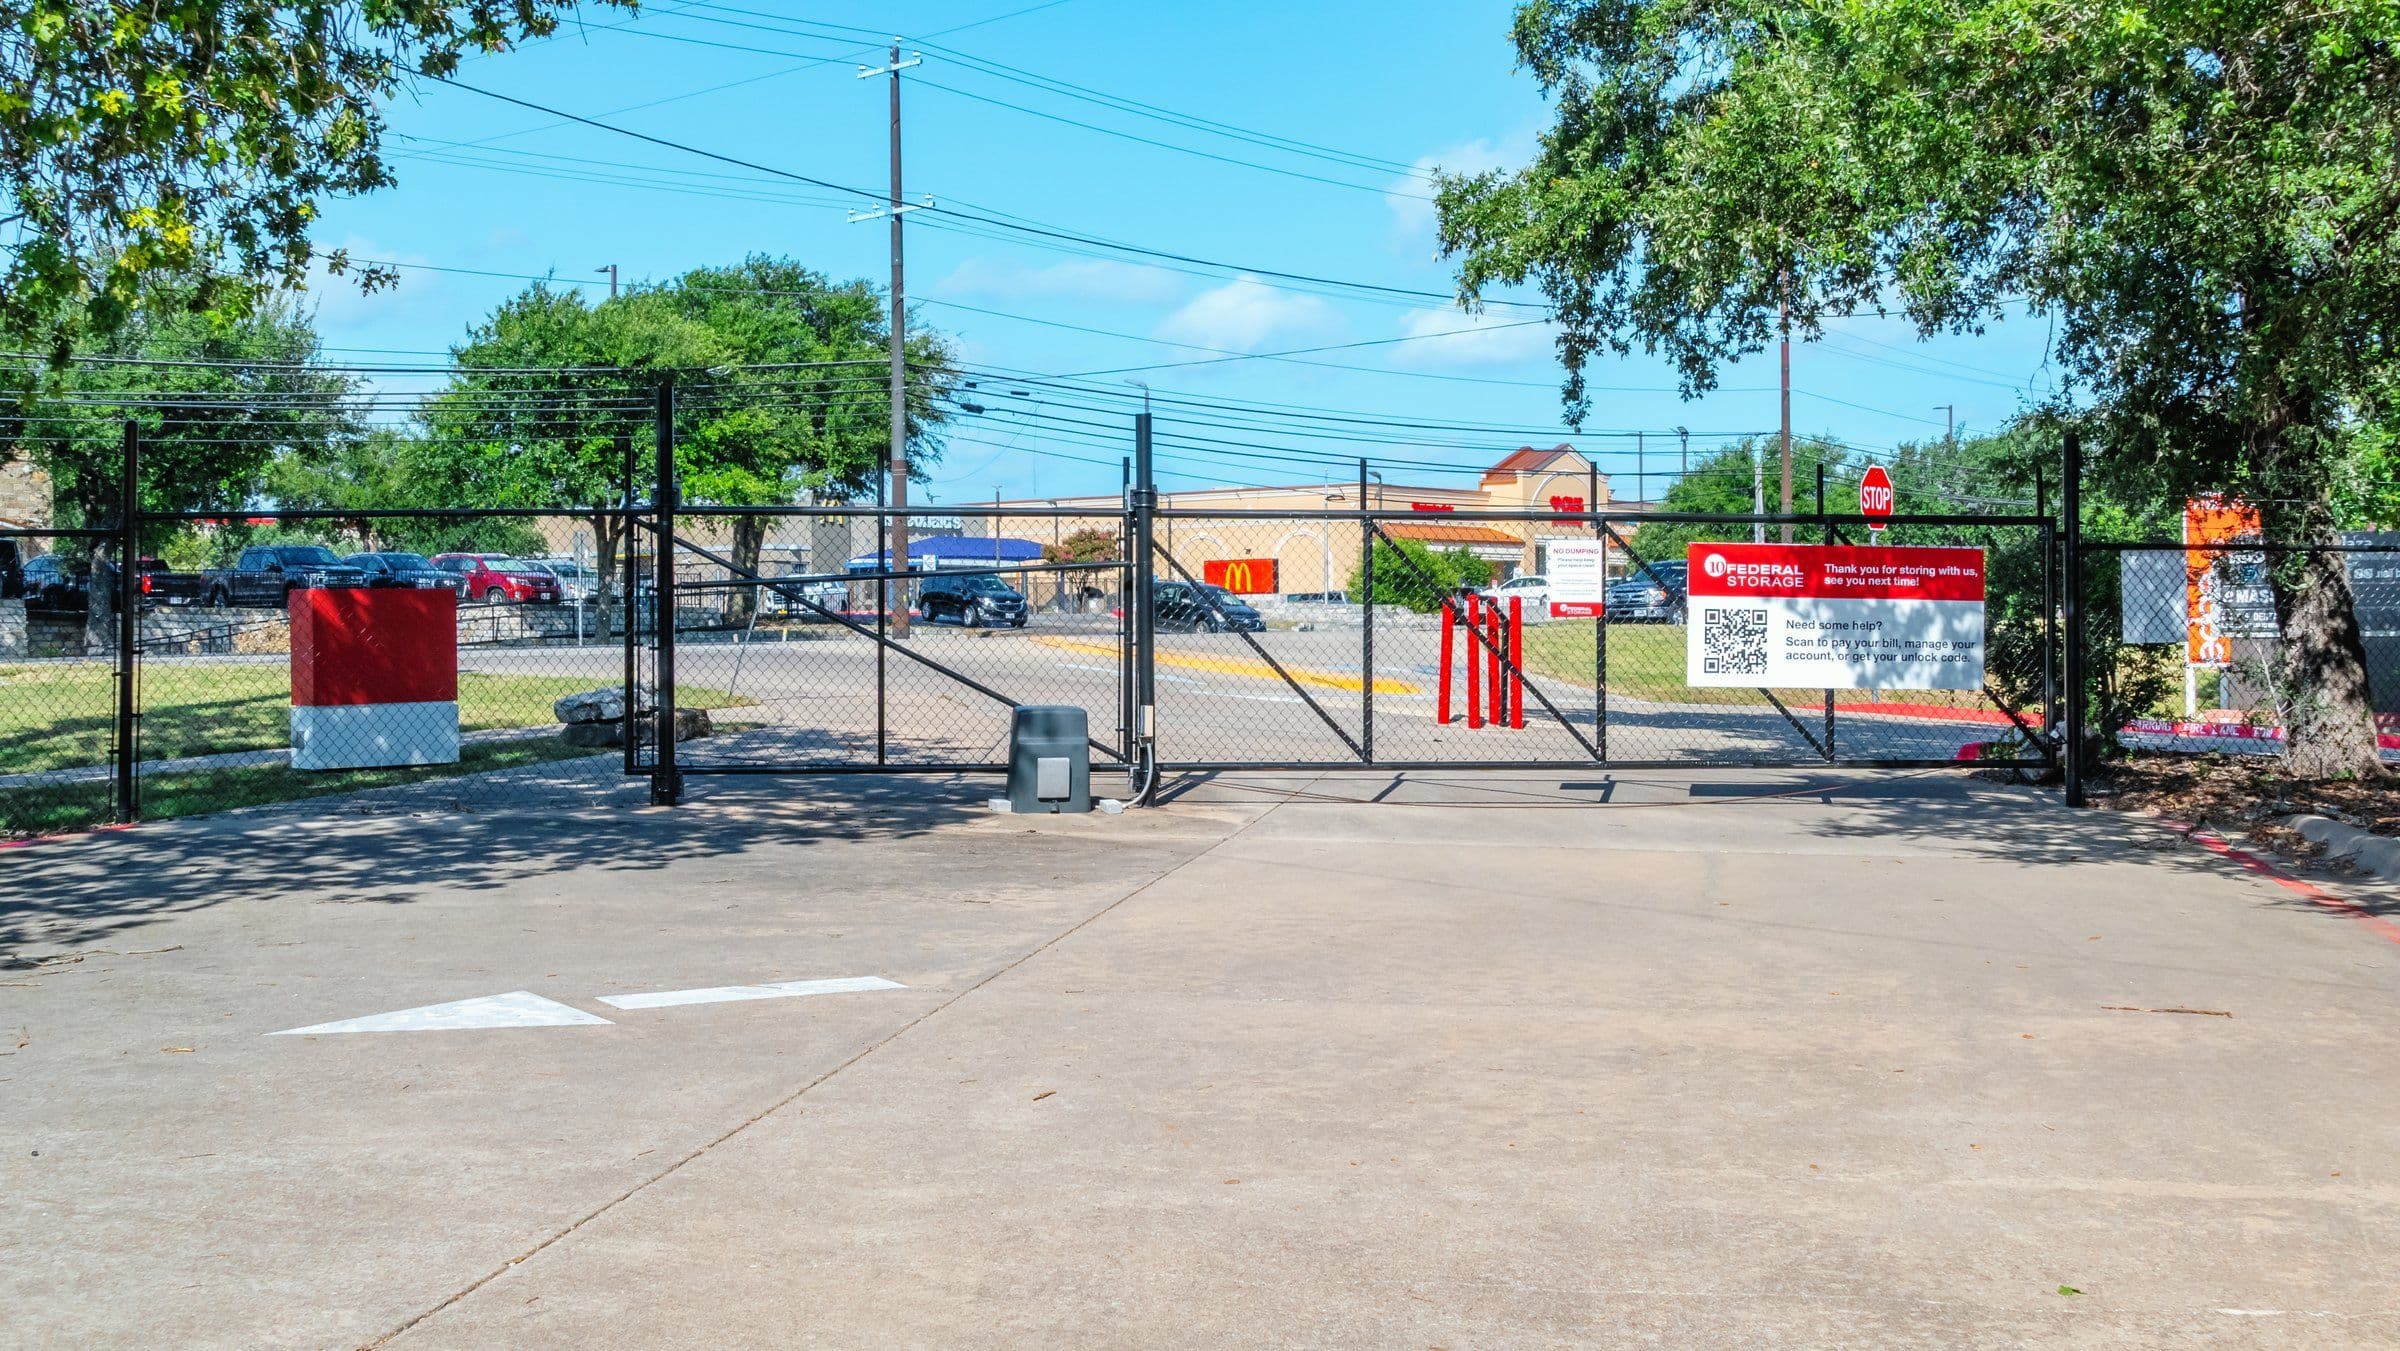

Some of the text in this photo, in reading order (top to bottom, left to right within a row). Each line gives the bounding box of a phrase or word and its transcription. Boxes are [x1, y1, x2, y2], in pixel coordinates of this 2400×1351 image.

[1863, 486, 1890, 510] STOP
[2341, 535, 2373, 546] laza
[1726, 564, 1804, 575] FEDERAL
[1824, 563, 1978, 577] Thank you for storing with us,
[1727, 576, 1804, 588] STORAGE
[1824, 576, 1919, 587] see you next time!
[1786, 619, 1882, 632] Need some help?
[1785, 637, 1975, 651] Scan to pay your bill, manage your
[1785, 652, 1971, 663] account, or get your unlock code.
[2183, 723, 2206, 734] FIRE
